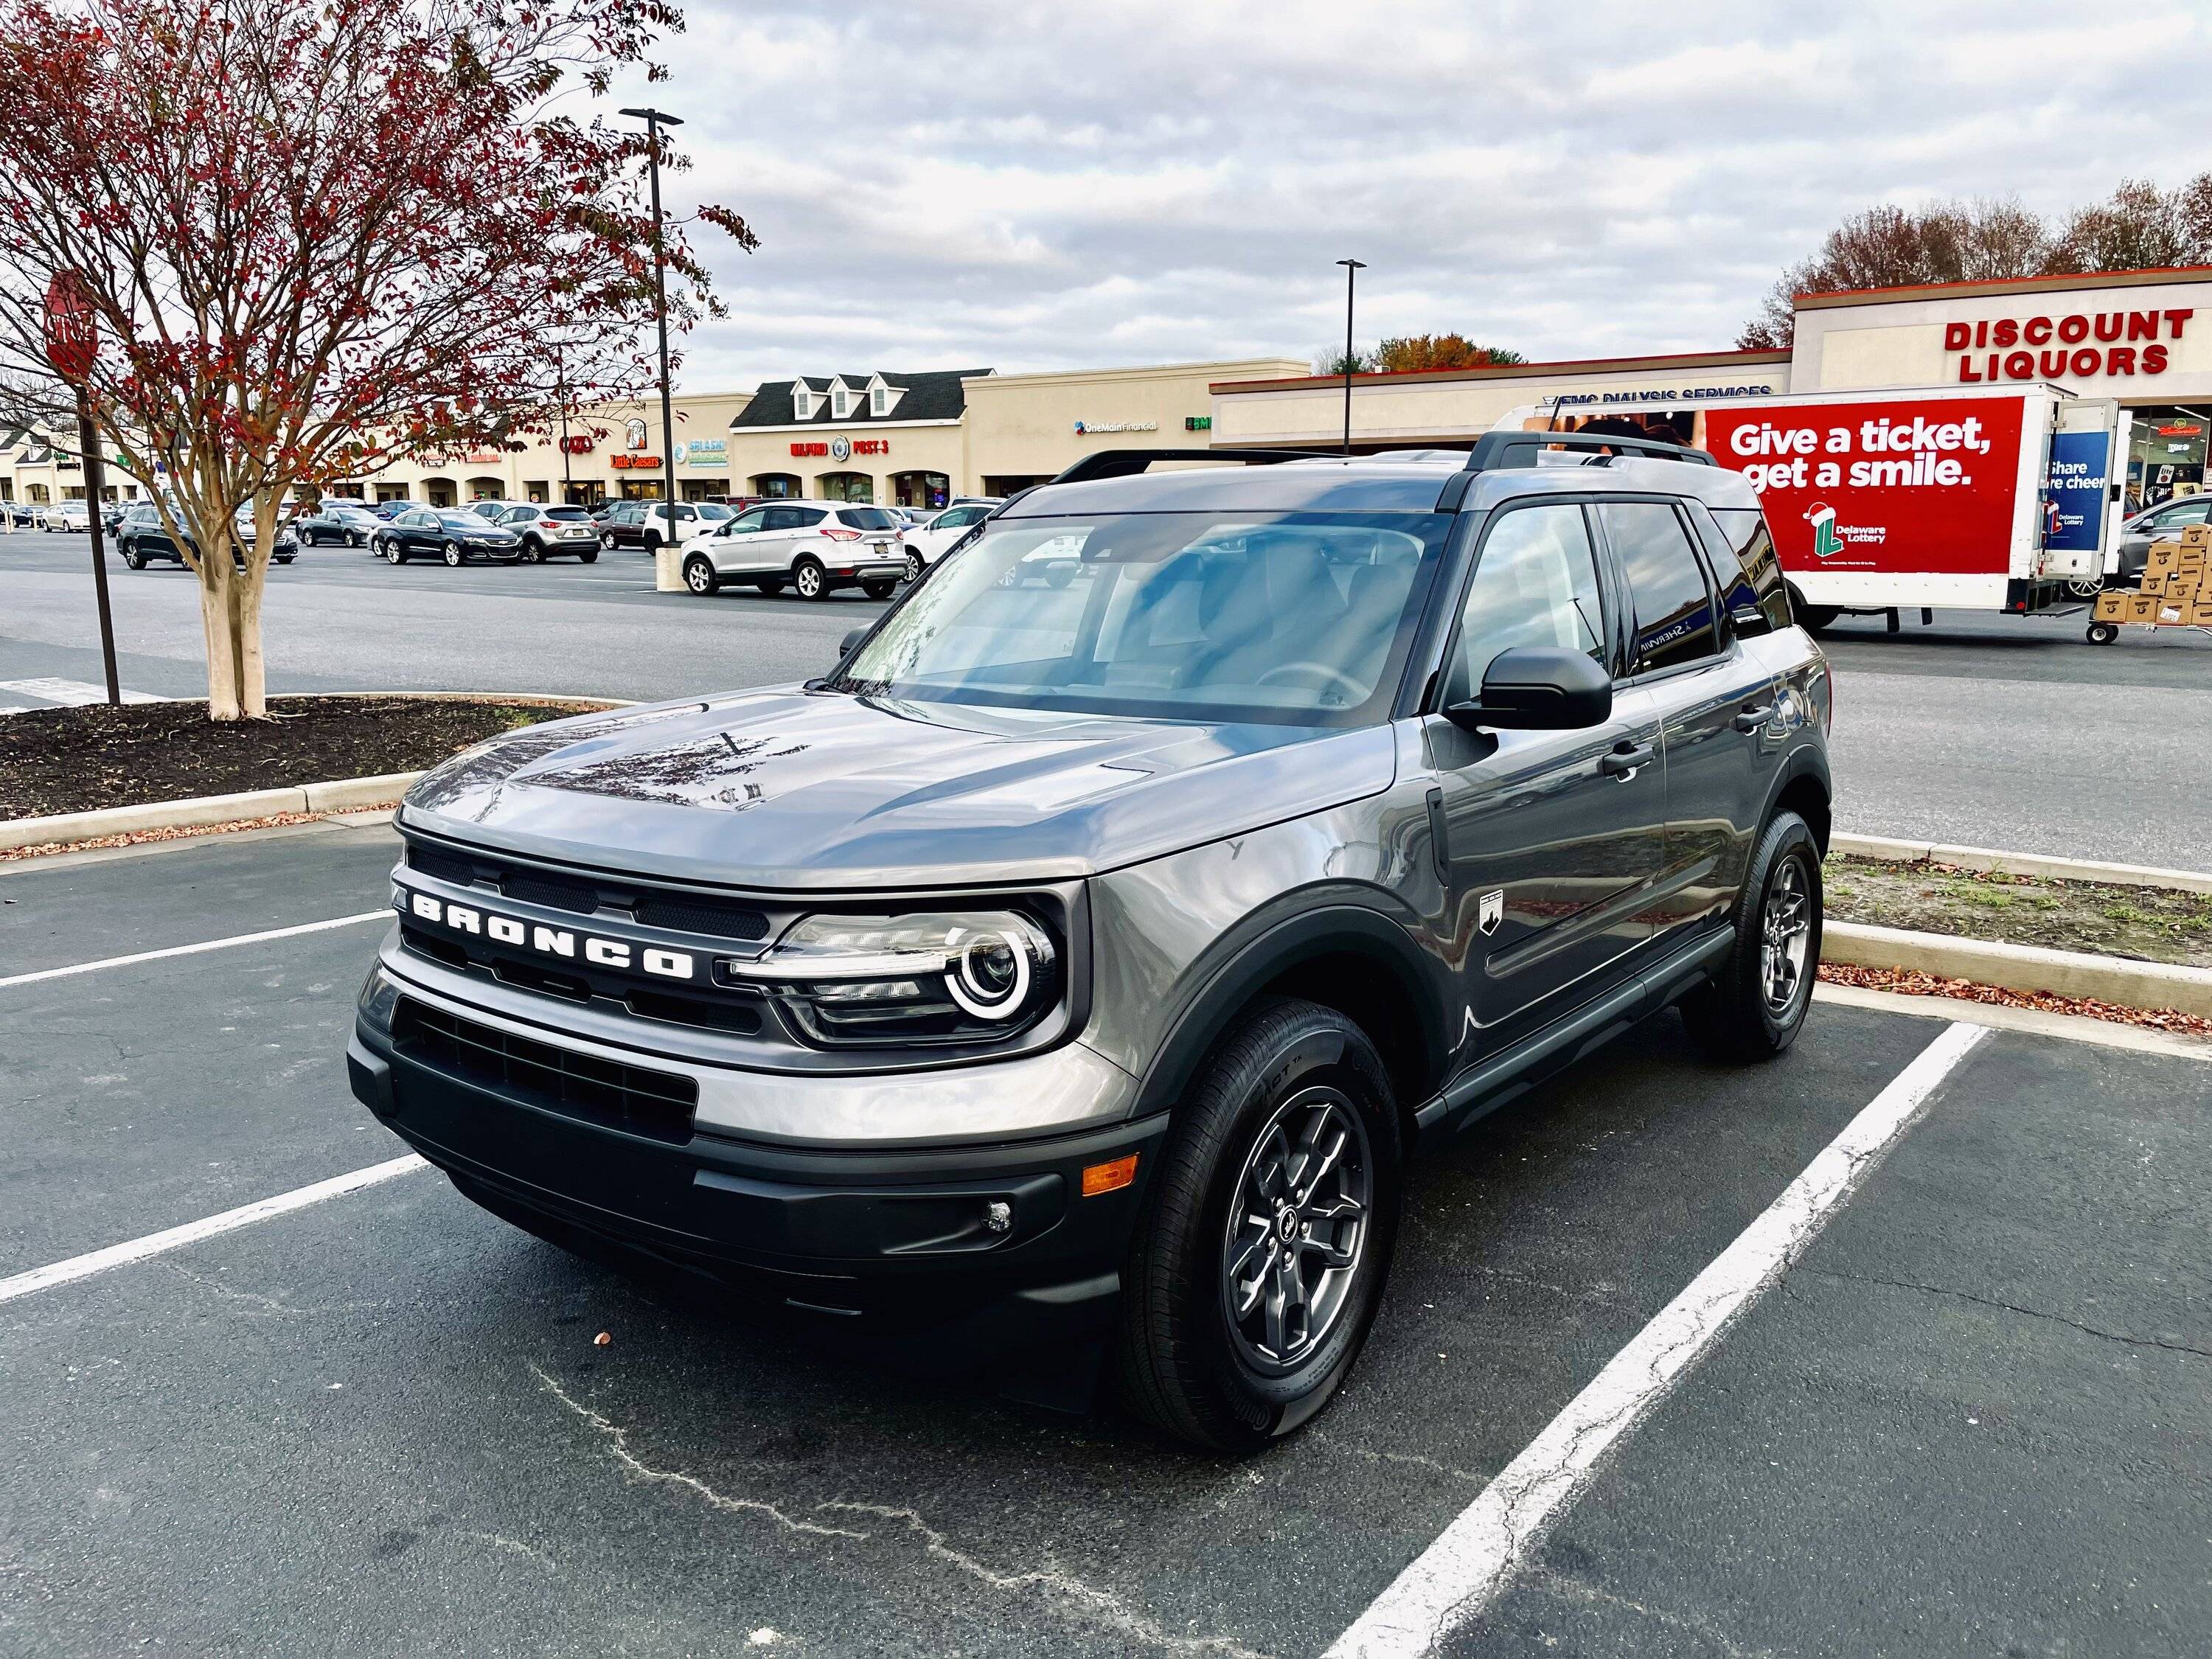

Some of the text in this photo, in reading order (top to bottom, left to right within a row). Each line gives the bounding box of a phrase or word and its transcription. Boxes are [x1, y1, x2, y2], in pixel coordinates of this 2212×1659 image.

[1944, 309, 2194, 351] DISCOUNT
[1959, 344, 2168, 382] LIQUORS
[1682, 386, 1773, 398] SERVICES
[1731, 417, 1991, 456] Give a ticket,
[610, 454, 659, 468] Little Caesars
[1742, 452, 1972, 495] get a smile.
[1836, 526, 1885, 534] Delaware
[1847, 534, 1885, 544] Lottery
[412, 893, 693, 979] BRONCO
